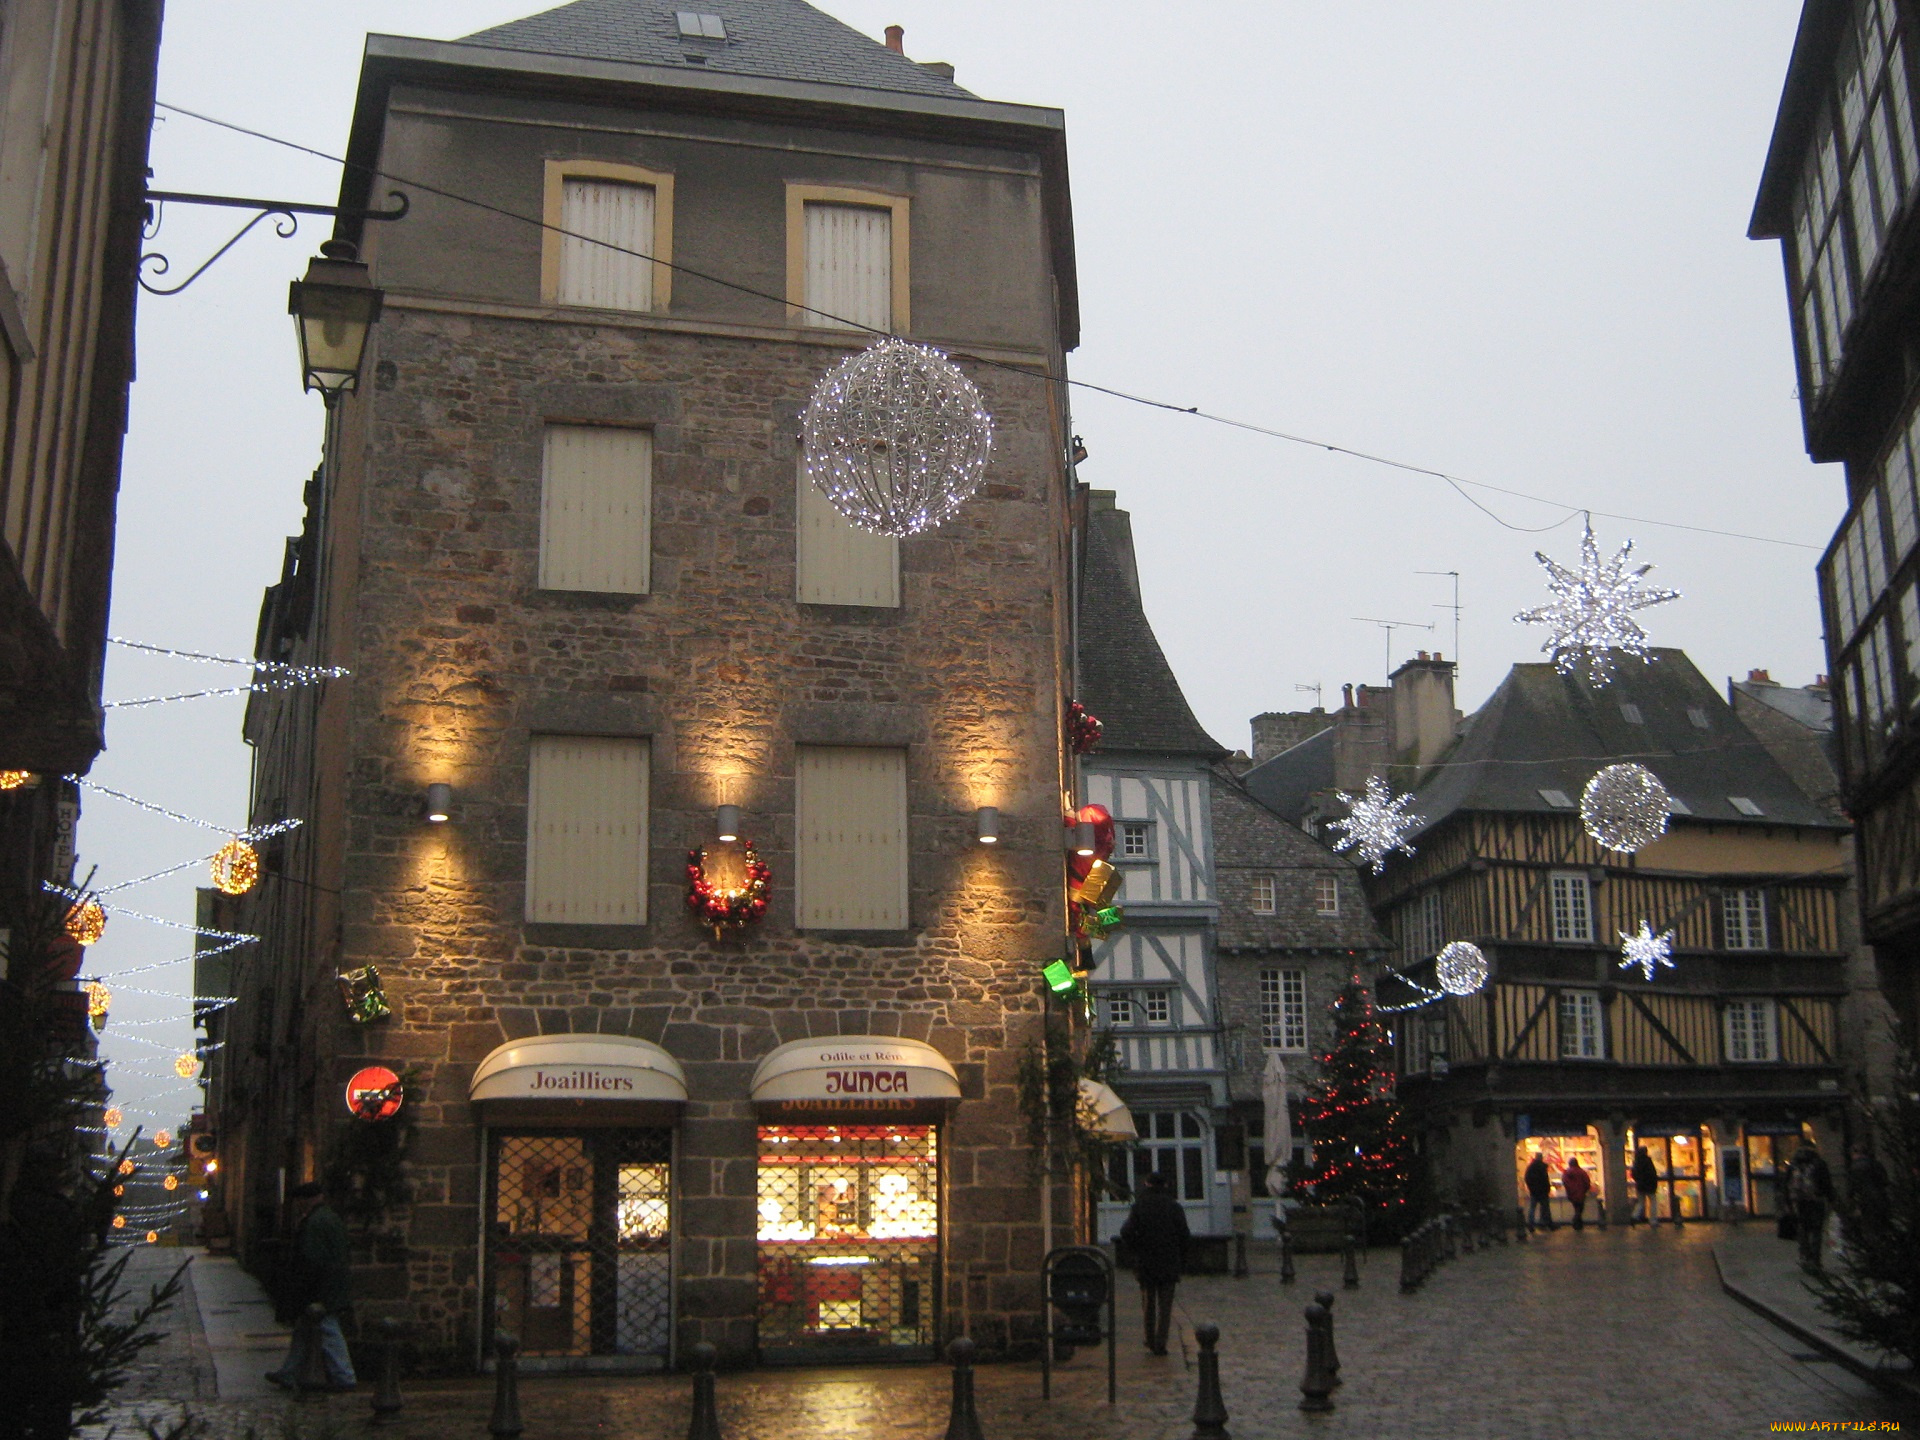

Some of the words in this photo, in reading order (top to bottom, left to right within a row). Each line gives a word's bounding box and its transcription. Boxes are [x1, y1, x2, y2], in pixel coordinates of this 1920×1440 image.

[820, 1051, 856, 1062] Odile
[859, 1053, 871, 1061] et
[530, 1071, 633, 1090] Joailliers
[826, 1070, 909, 1093] JUNCA
